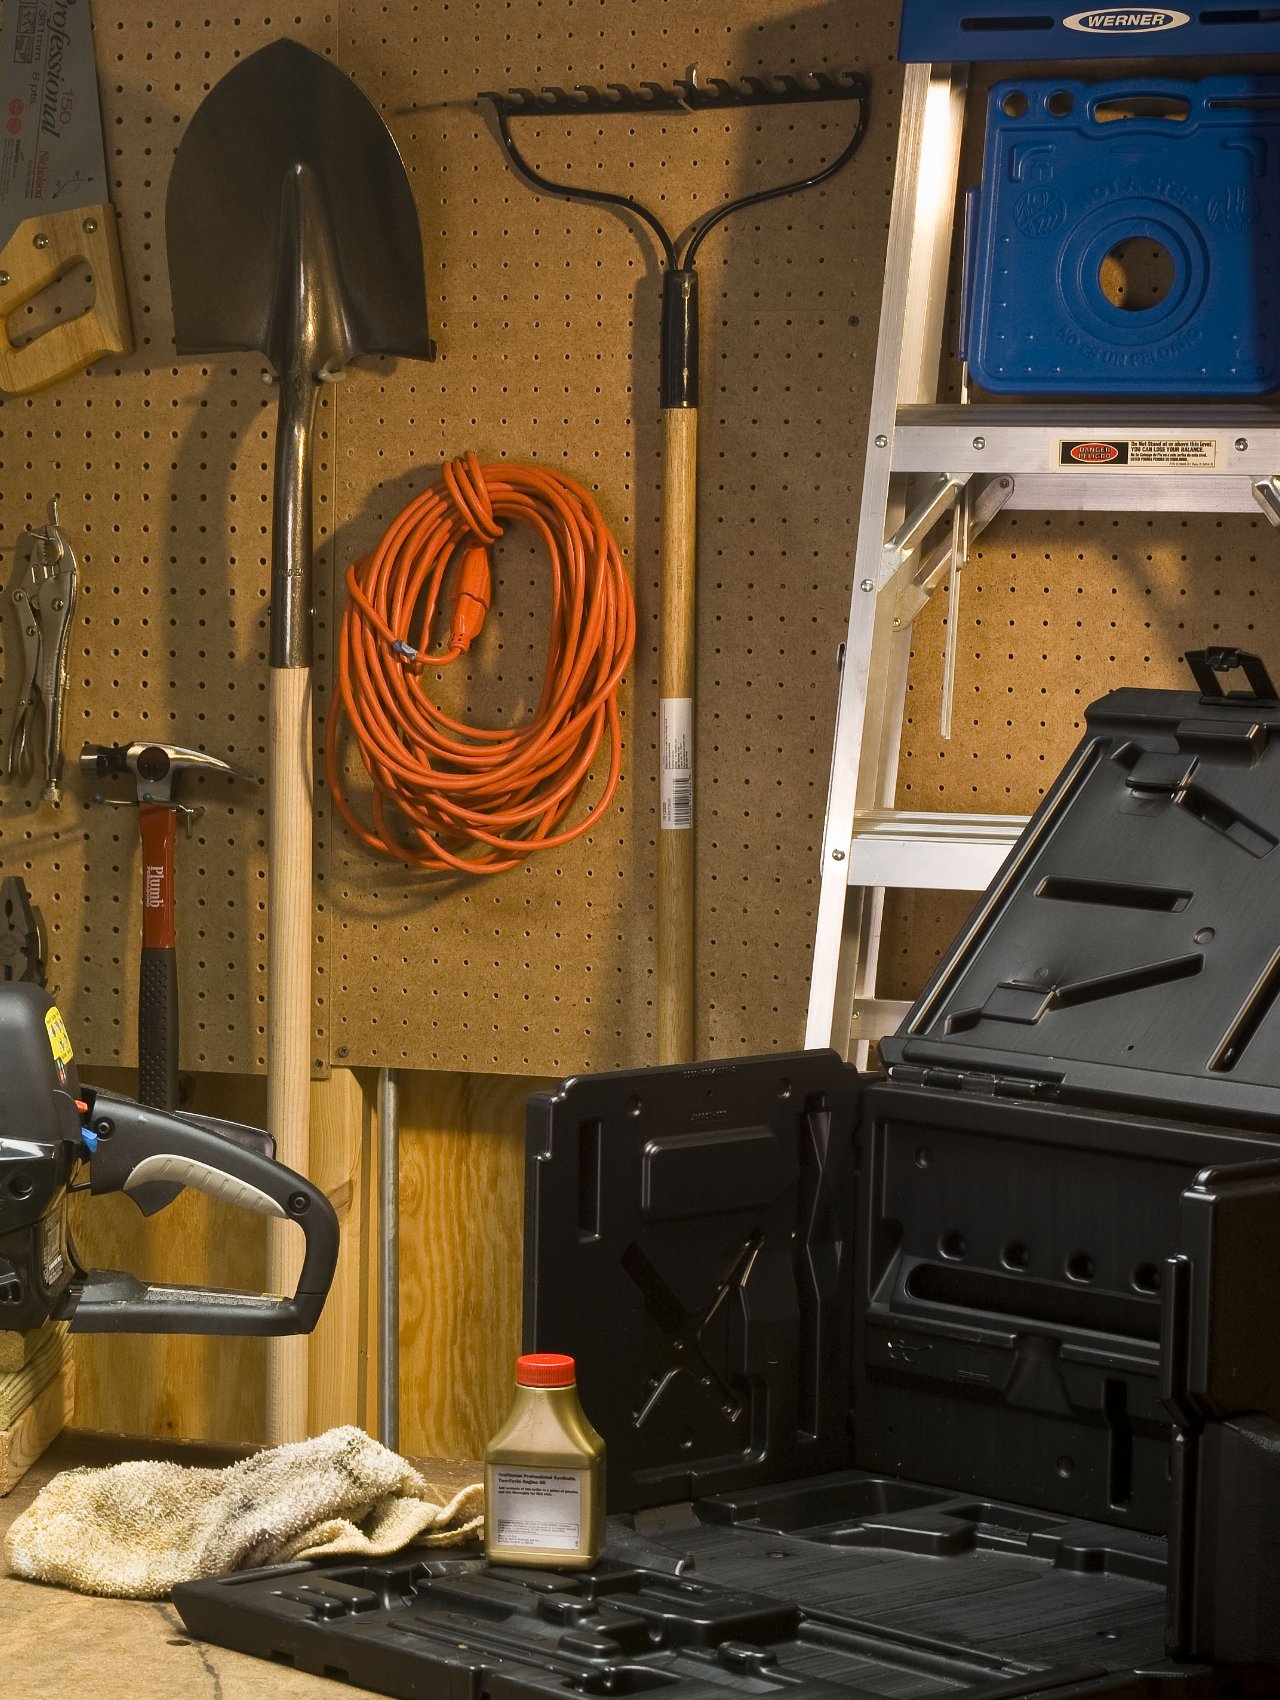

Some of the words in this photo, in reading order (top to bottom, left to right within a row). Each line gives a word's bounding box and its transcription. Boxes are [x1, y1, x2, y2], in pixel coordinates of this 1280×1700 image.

[1088, 14, 1165, 27] WERNER
[60, 88, 74, 124] 150
[34, 150, 49, 200] Nicholson
[150, 865, 164, 908] Plumb
